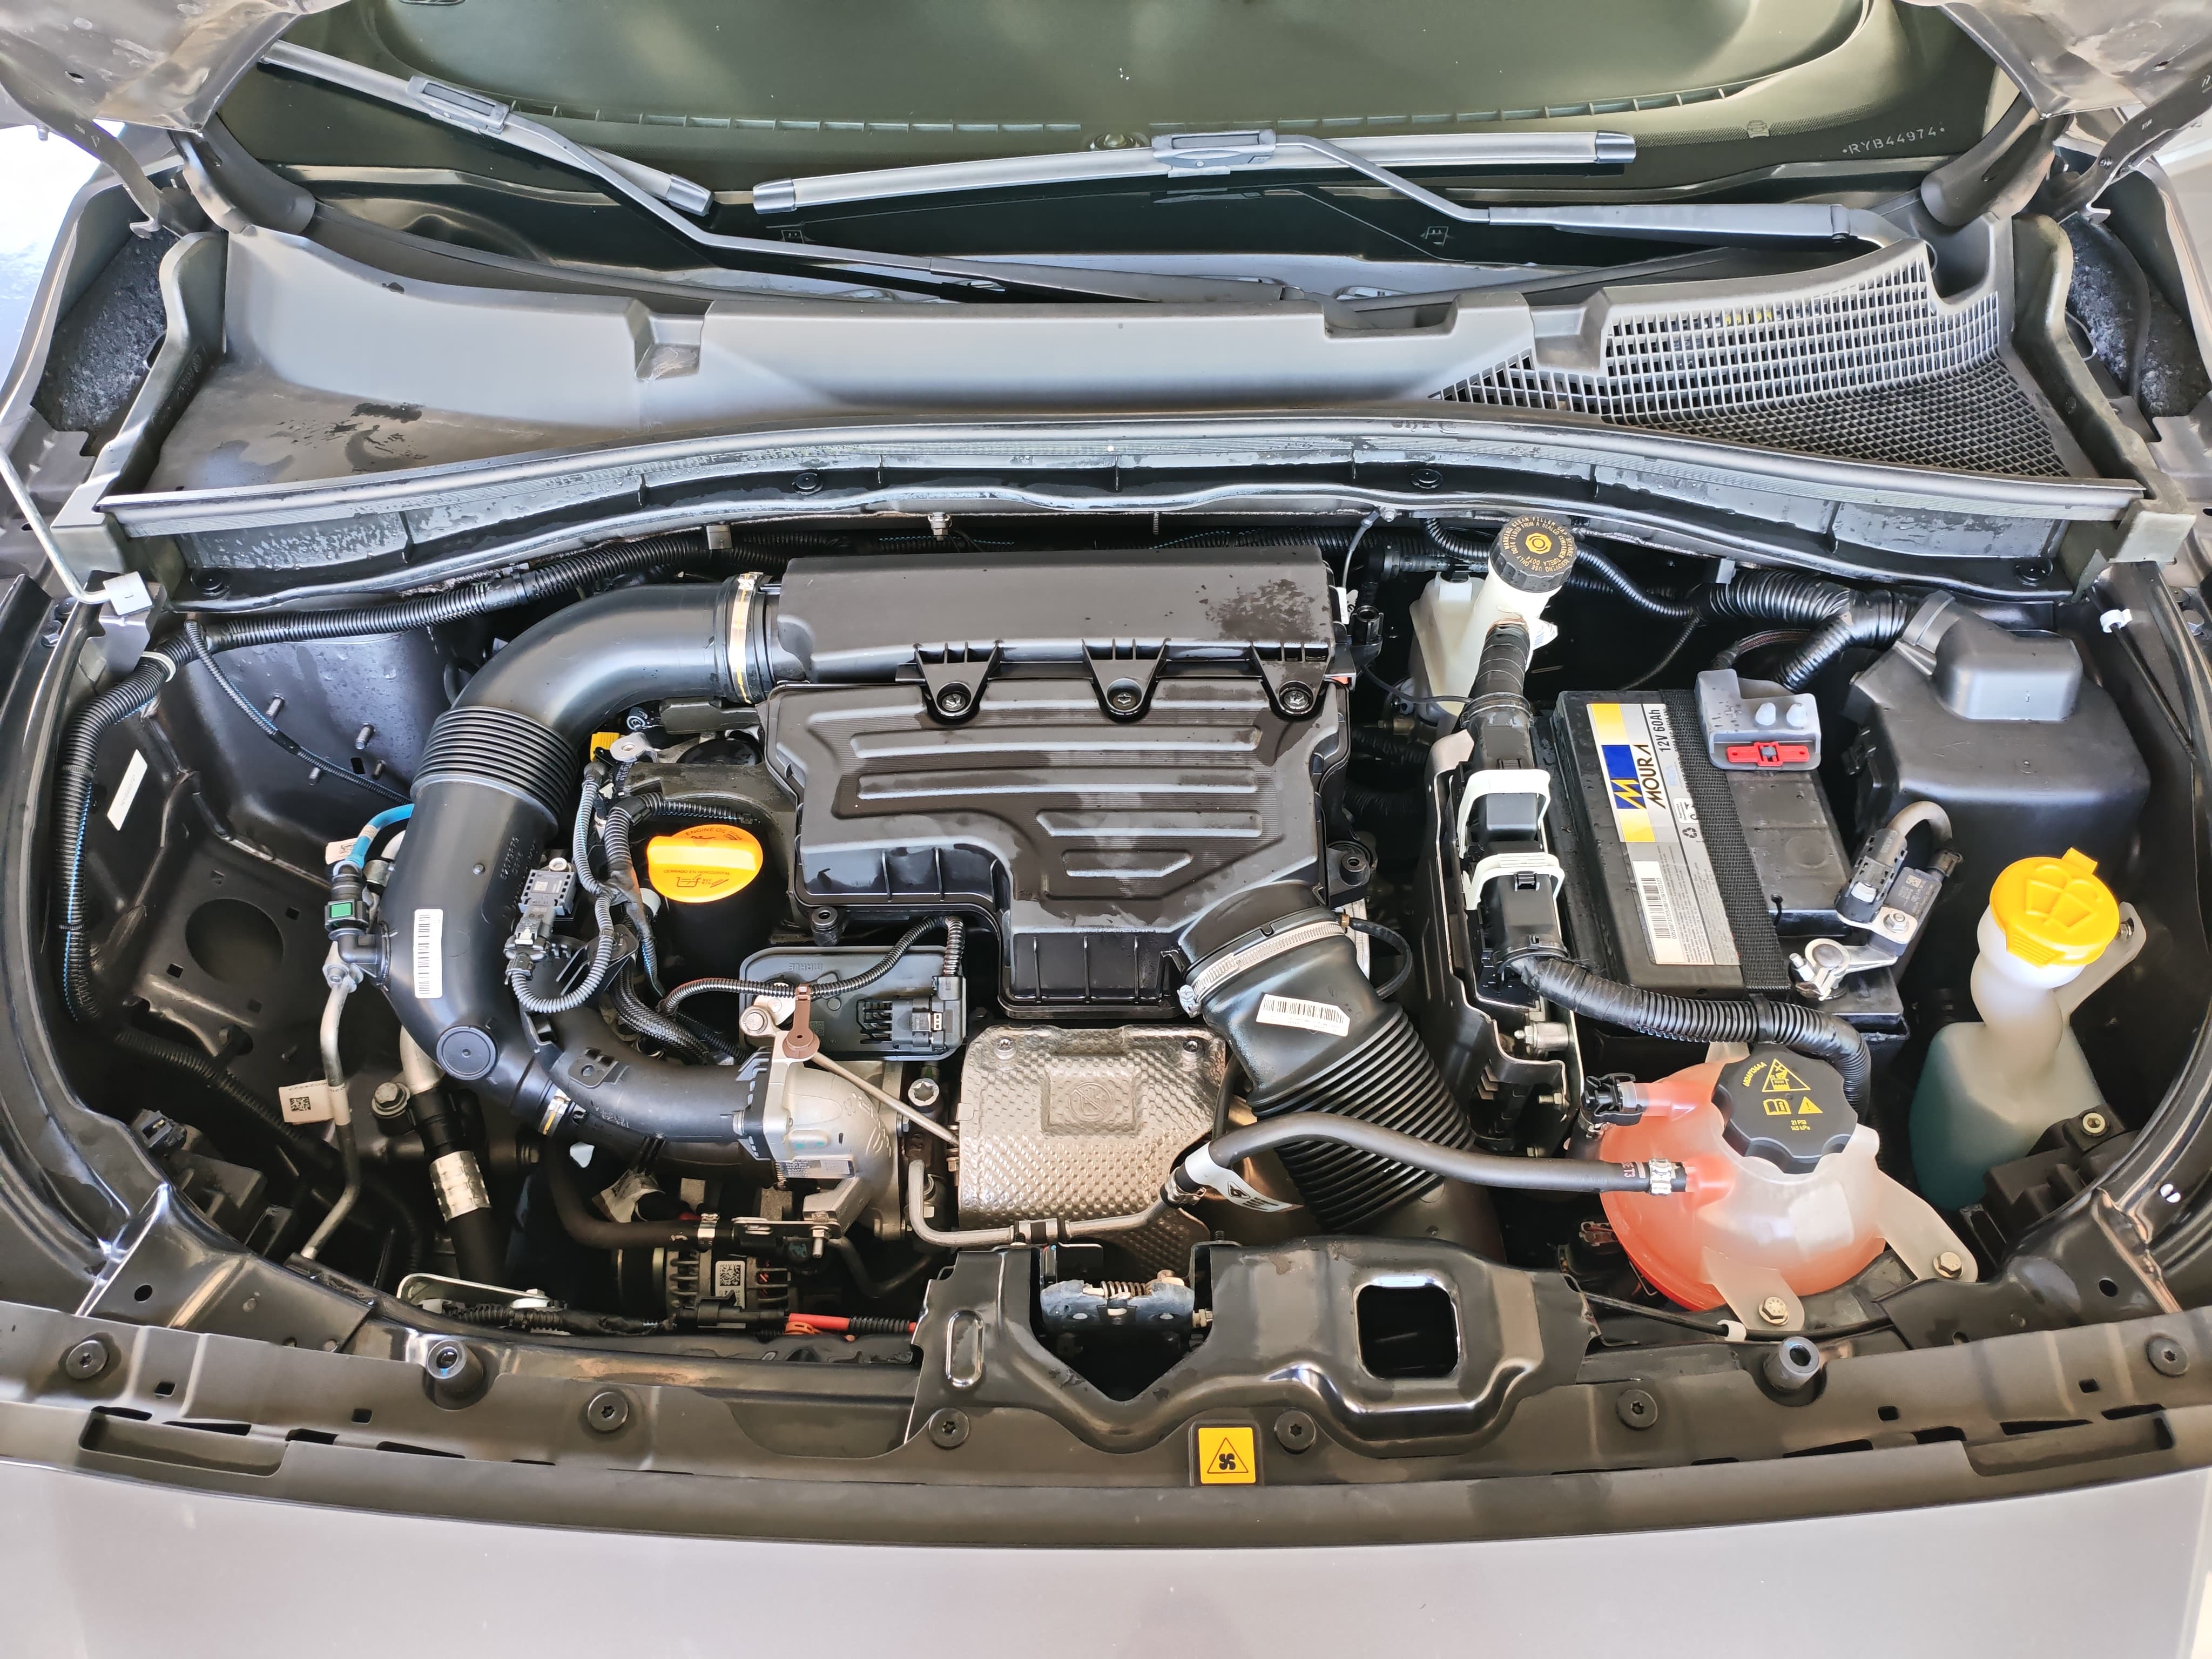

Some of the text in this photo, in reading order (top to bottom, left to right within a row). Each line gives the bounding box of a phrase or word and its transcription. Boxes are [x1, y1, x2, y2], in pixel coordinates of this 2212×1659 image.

[1512, 517, 1529, 527] CLEAN
[1533, 516, 1556, 526] FILLER
[1512, 527, 1522, 541] FLUID
[1542, 523, 1560, 535] SEALED
[1557, 526, 1568, 536] CAP
[1502, 527, 1513, 550] WARNING
[1516, 555, 1530, 567] ONLY
[1545, 559, 1570, 572] REMOVING
[1649, 710, 1671, 752] 12V 60Ah
[1633, 744, 1666, 810] MOURA
[685, 827, 714, 835] ENGINE
